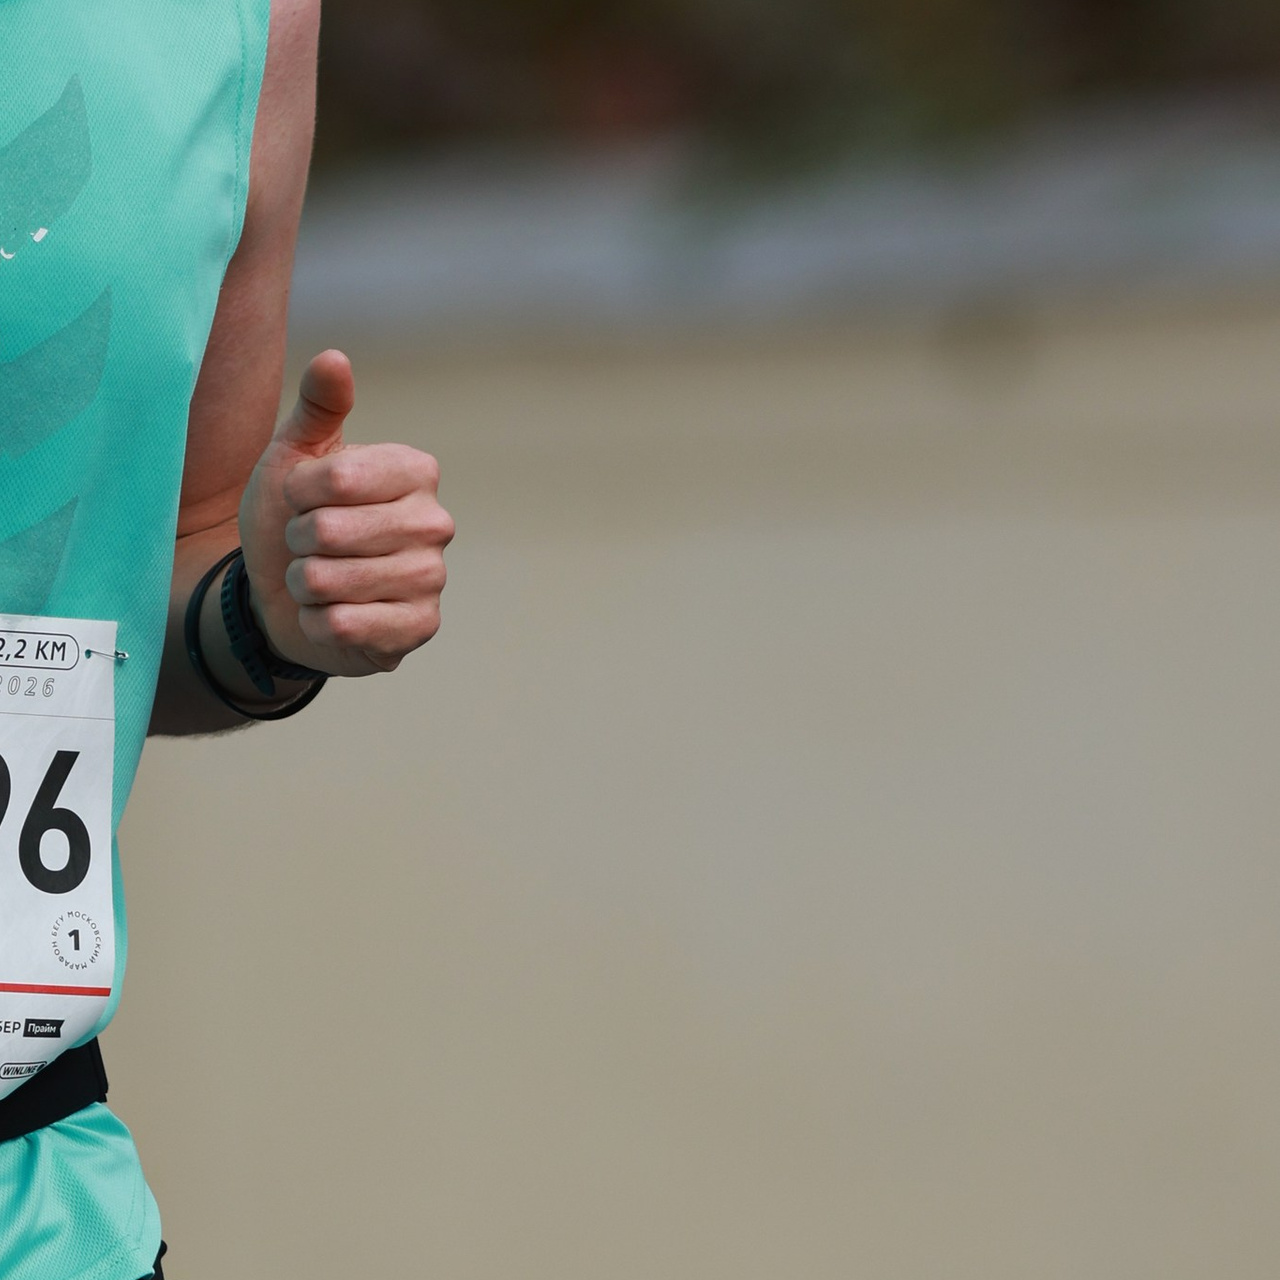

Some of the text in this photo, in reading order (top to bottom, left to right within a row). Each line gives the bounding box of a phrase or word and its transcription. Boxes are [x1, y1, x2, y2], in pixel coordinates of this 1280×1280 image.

[34, 639, 67, 662] КМ
[51, 911, 101, 970] БЕГУ МОСКОВСКИЙ МАРАФОН
[67, 928, 80, 951] 1
[27, 1023, 57, 1034] Прайм
